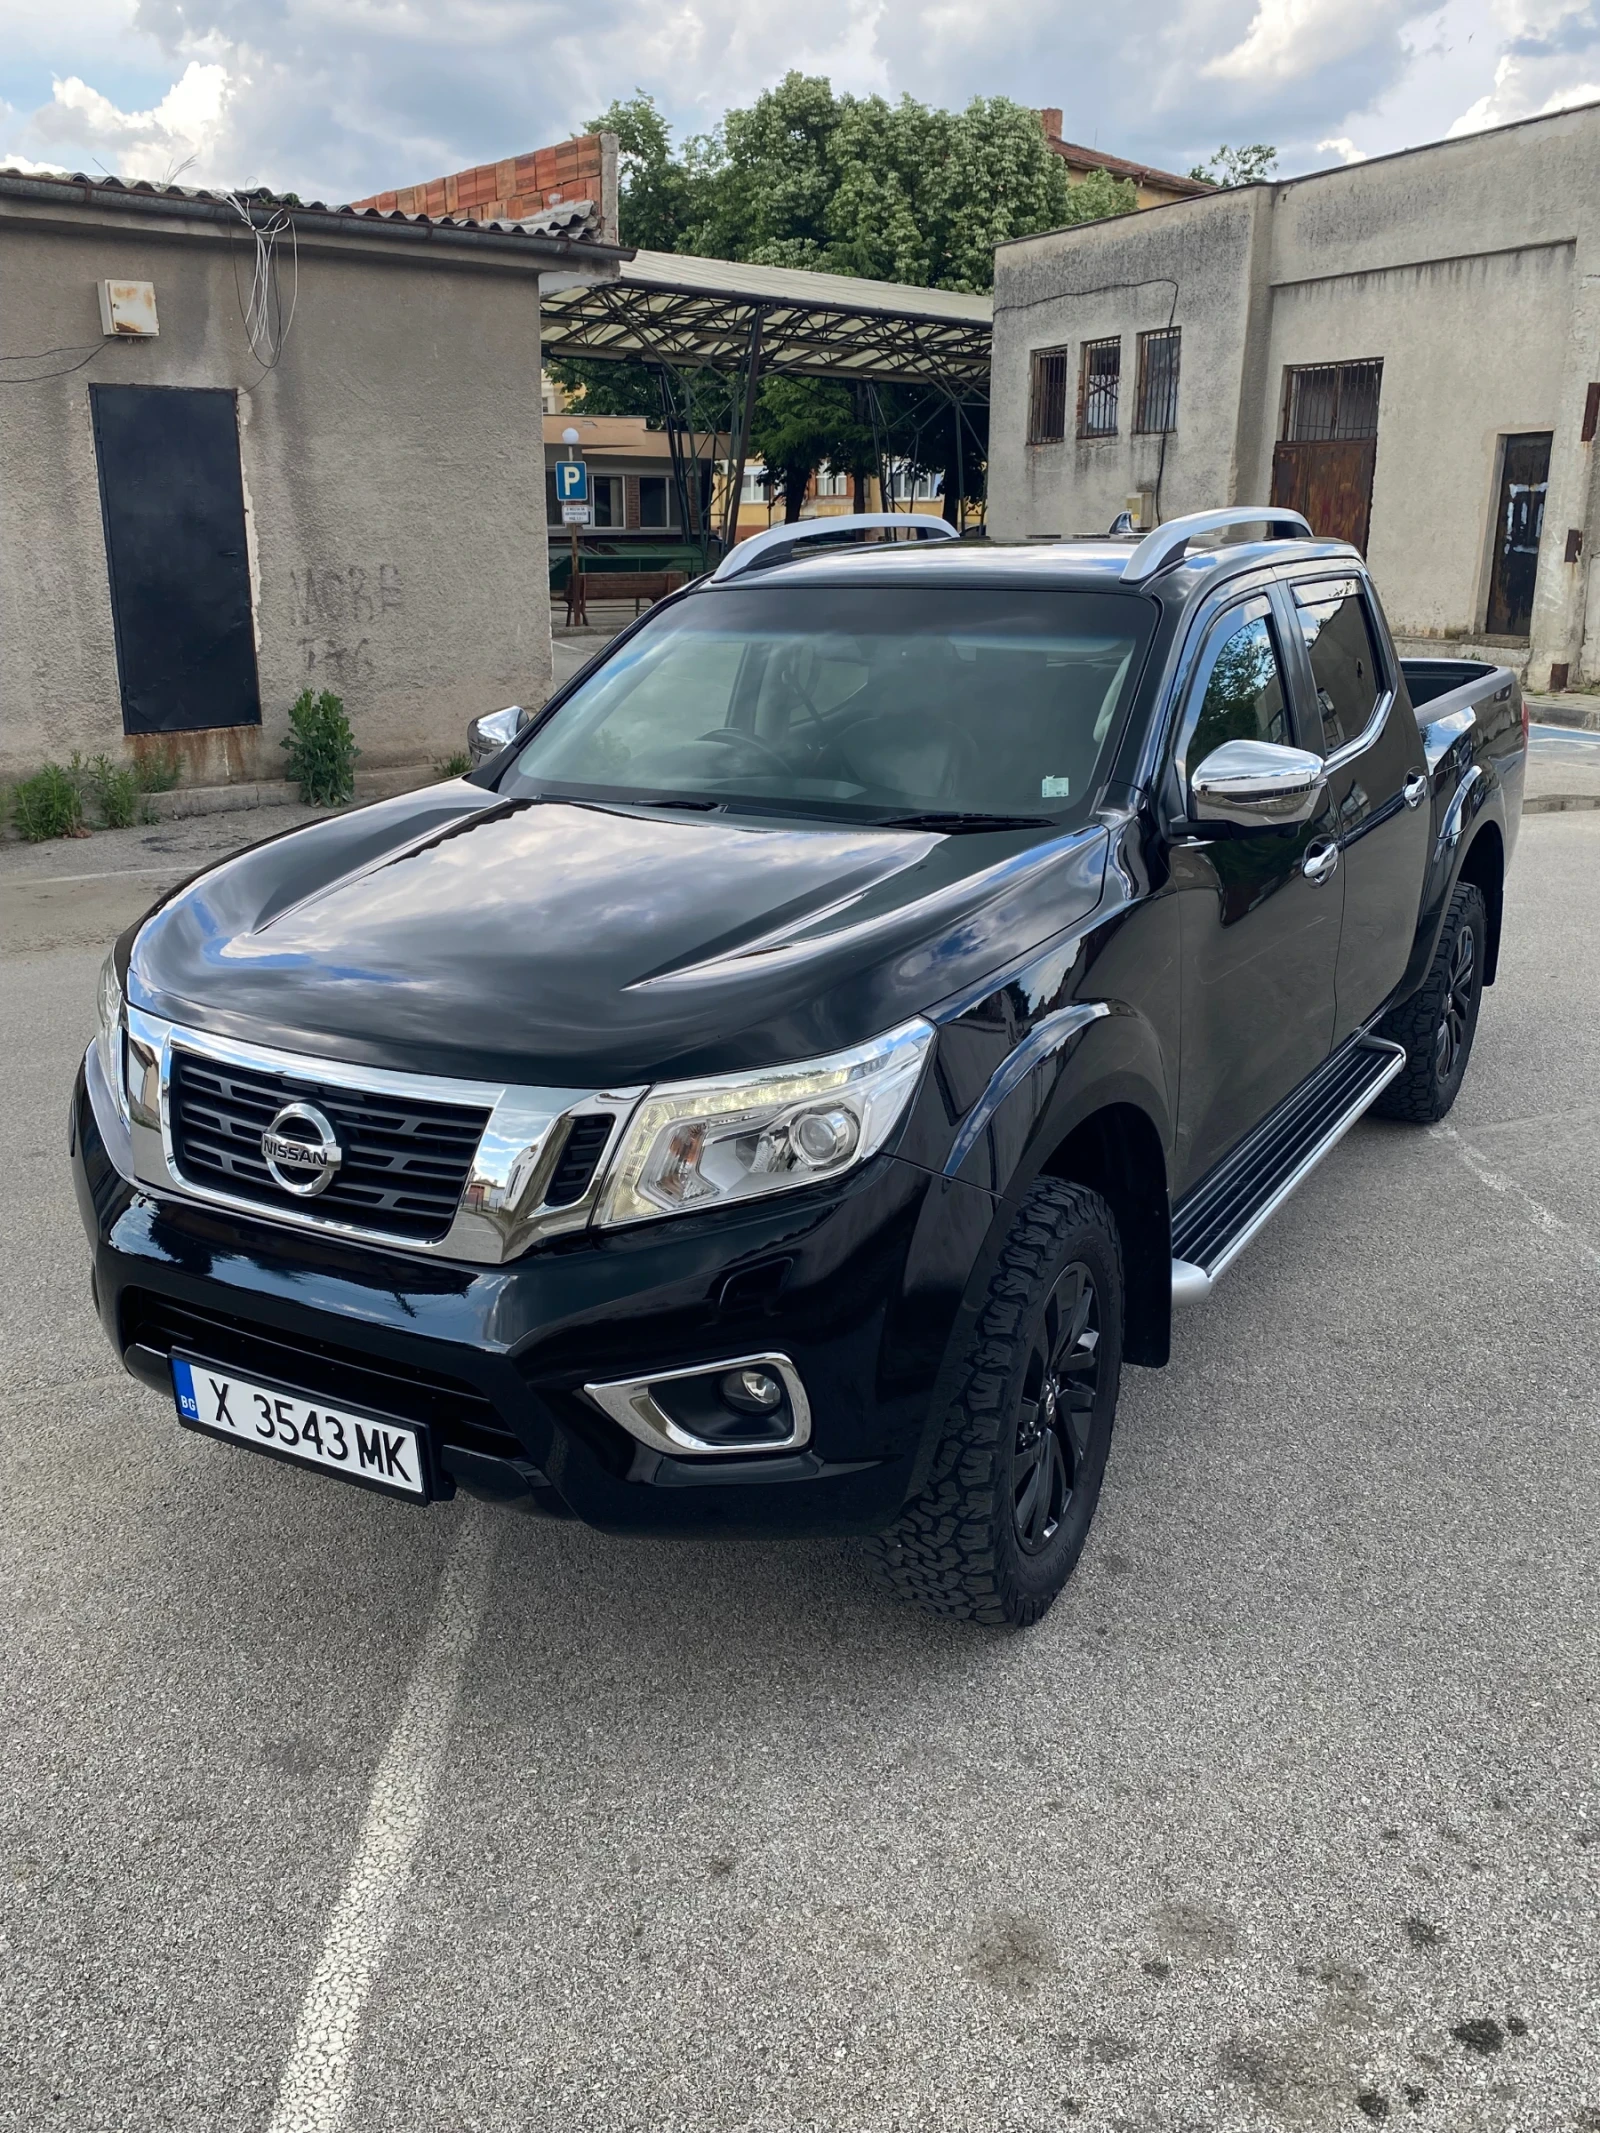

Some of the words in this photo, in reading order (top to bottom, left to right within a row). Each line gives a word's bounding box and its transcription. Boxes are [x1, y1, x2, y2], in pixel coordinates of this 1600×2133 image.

[563, 466, 580, 496] P
[263, 1139, 328, 1166] NISSAN
[180, 1394, 196, 1411] BG
[253, 1393, 349, 1461] 3543
[355, 1423, 413, 1483] MK
